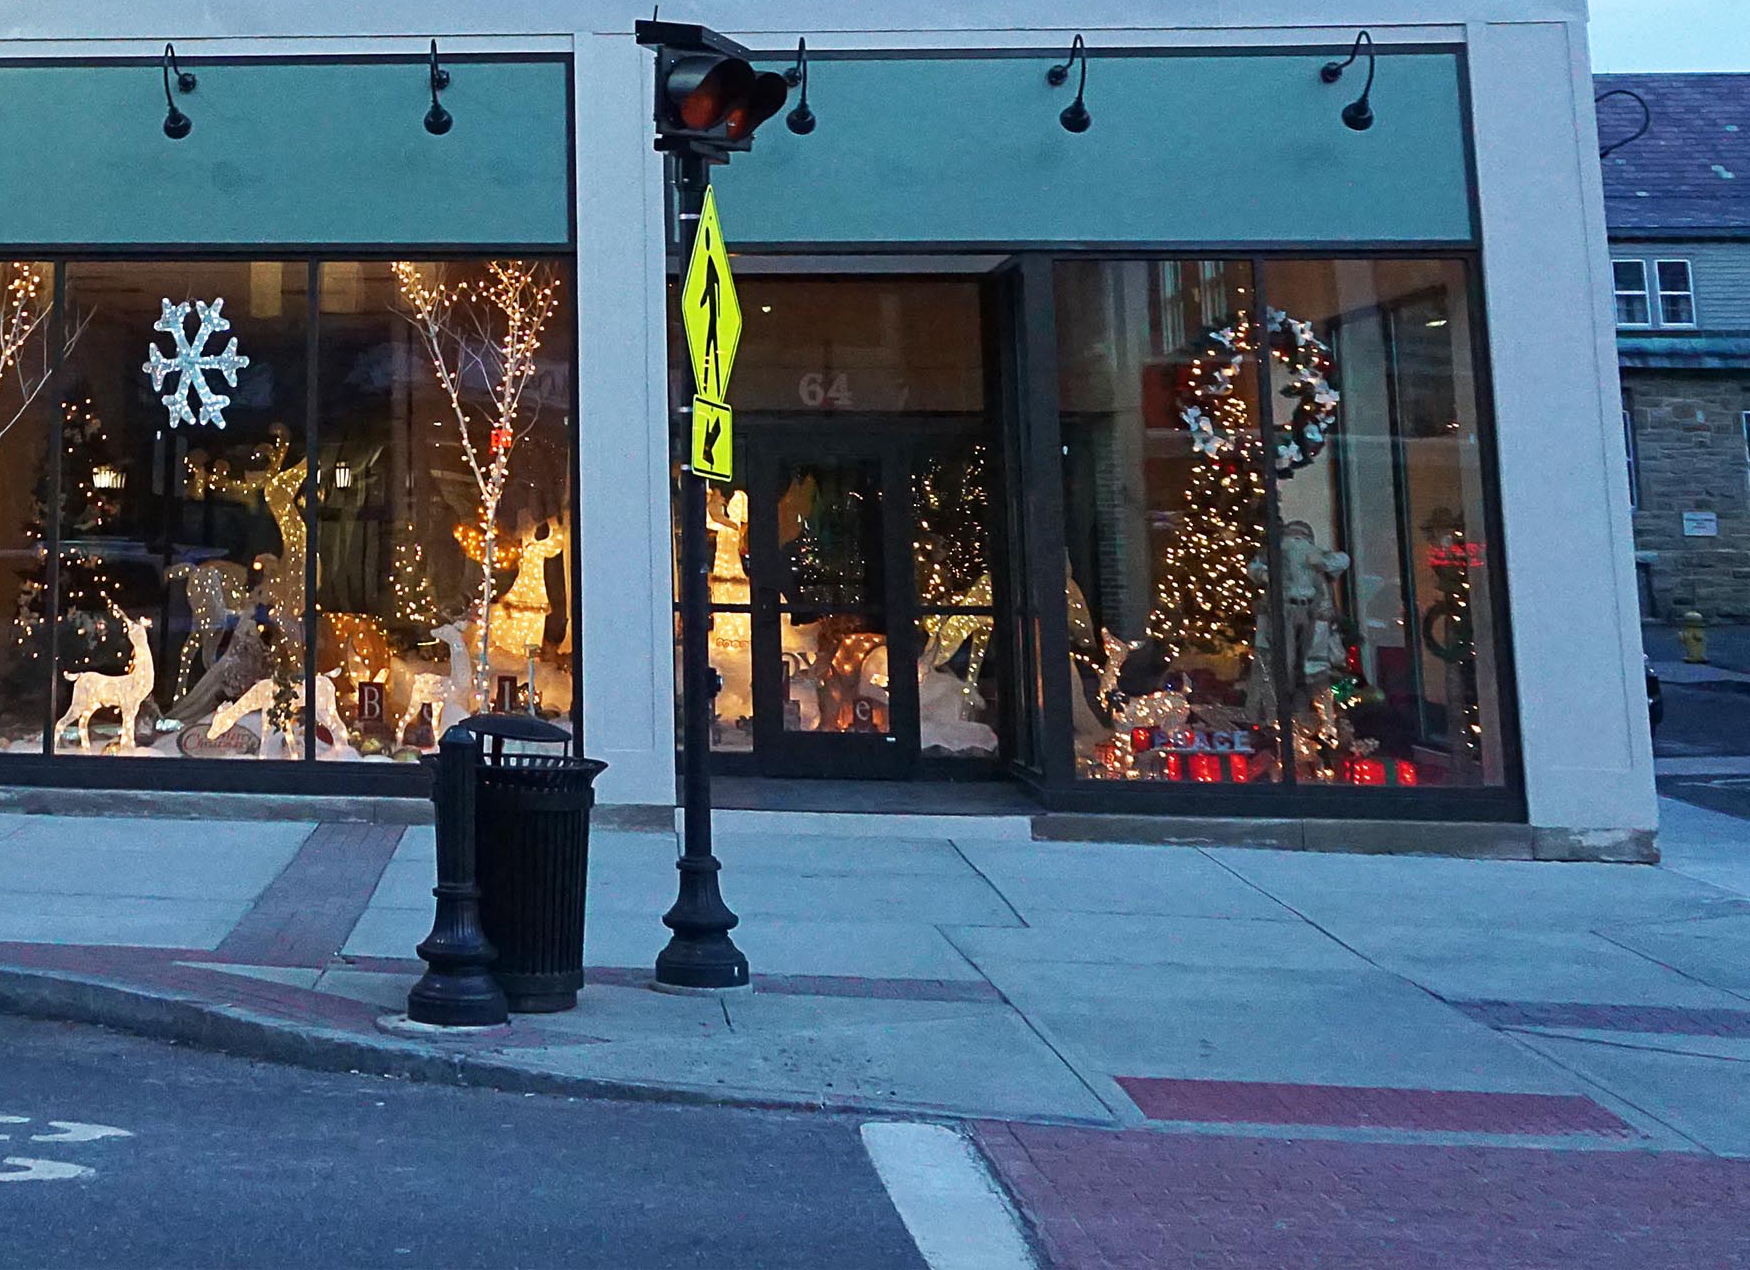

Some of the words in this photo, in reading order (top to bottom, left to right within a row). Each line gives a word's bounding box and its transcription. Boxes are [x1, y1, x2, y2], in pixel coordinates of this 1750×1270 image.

[798, 372, 853, 406] 64
[363, 686, 381, 720] B
[855, 700, 872, 721] e
